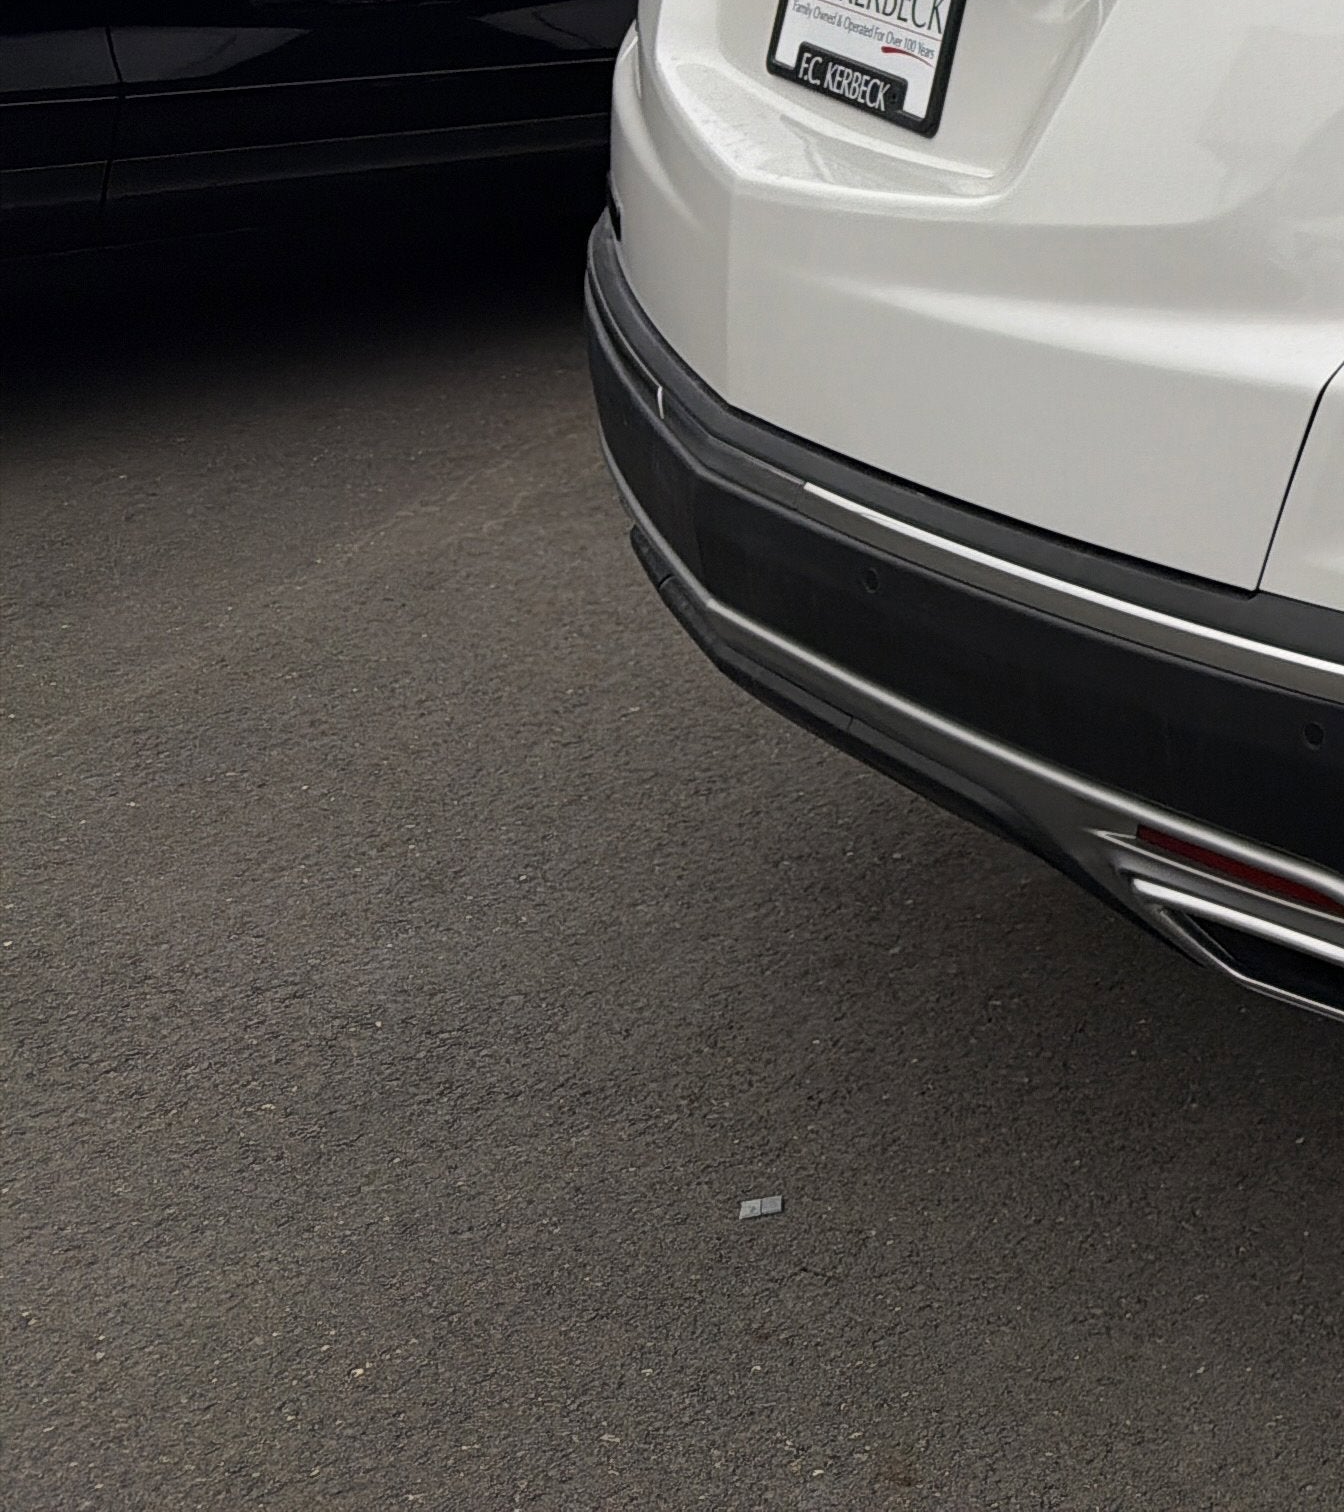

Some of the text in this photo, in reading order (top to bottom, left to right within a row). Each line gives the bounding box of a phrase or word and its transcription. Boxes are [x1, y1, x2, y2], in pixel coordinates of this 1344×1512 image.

[813, 6, 836, 27] Owned
[843, 17, 875, 37] Operated
[874, 29, 885, 42] For
[885, 31, 903, 46] Over
[903, 37, 917, 52] 100
[917, 42, 936, 59] Years
[798, 52, 891, 112] F.C. KERBECK
